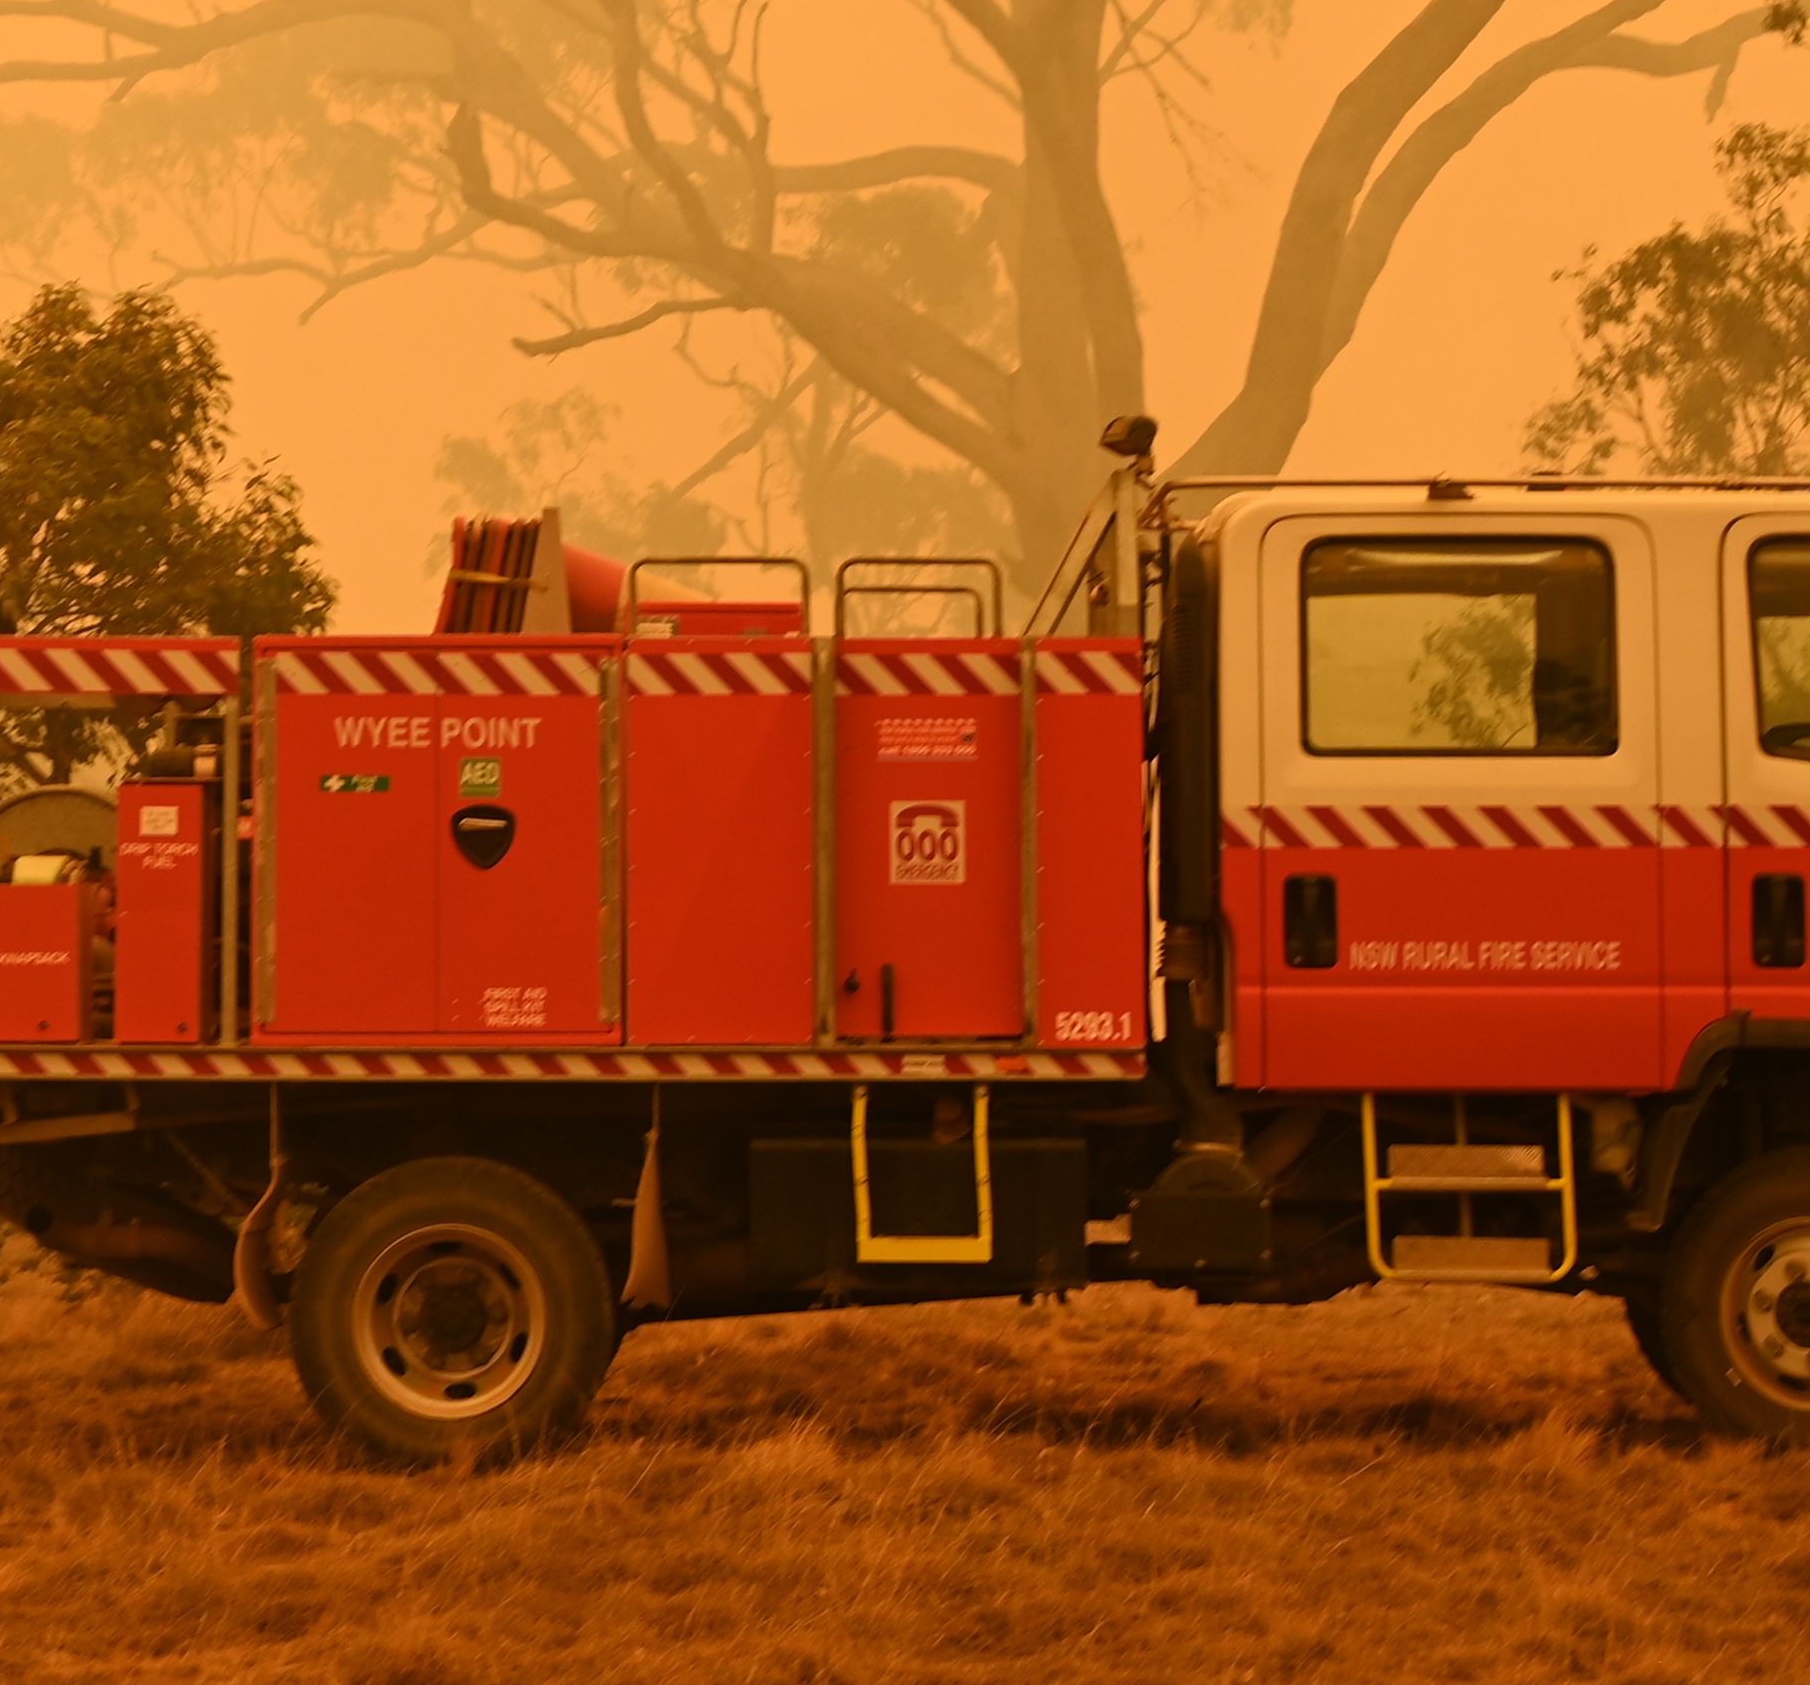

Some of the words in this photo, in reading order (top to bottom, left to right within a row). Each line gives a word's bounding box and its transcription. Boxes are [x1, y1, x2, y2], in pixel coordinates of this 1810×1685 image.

[333, 716, 431, 748] WYEE
[440, 716, 542, 749] POINT
[460, 761, 500, 785] AED
[153, 842, 199, 856] TORCH
[896, 828, 959, 862] 000
[142, 856, 178, 869] FUEL
[895, 864, 959, 880] EMERGENCY
[1350, 941, 1399, 970] NSW
[1402, 941, 1475, 970] RURAL
[1478, 941, 1526, 970] FIRE
[1530, 941, 1621, 970] SERVICE
[482, 987, 521, 1000] FIRST
[1055, 1011, 1132, 1041] 5293.1
